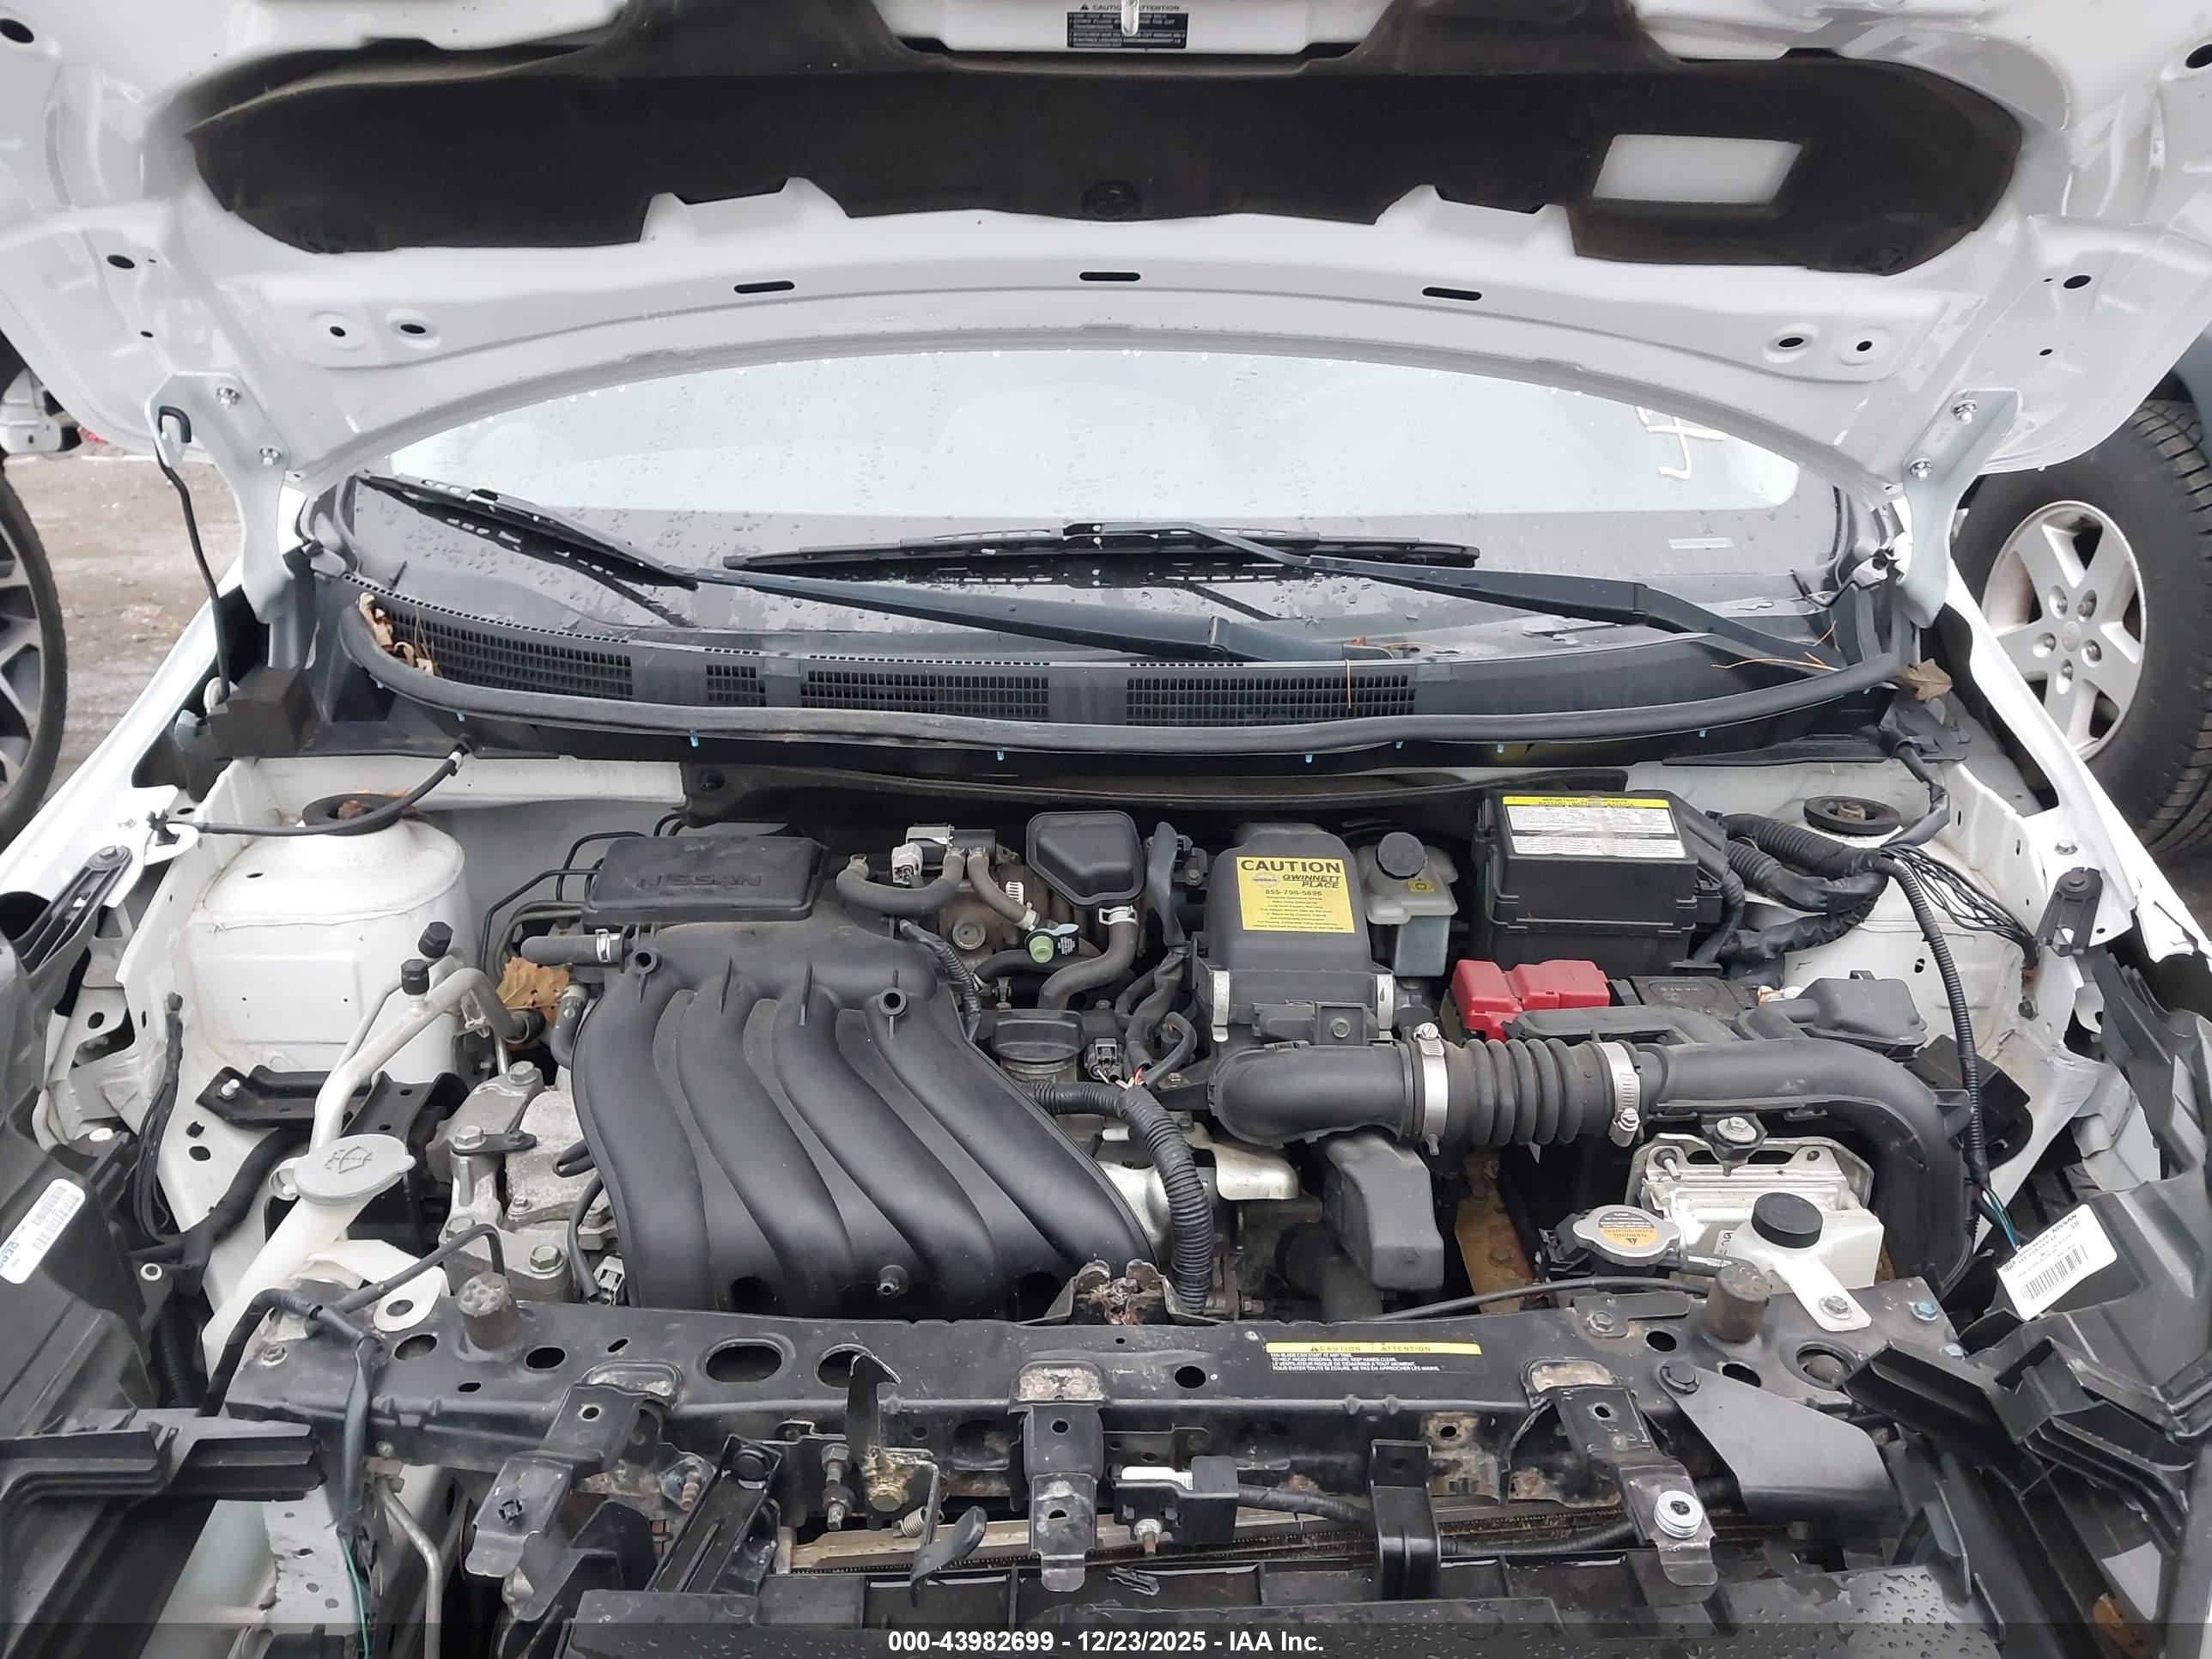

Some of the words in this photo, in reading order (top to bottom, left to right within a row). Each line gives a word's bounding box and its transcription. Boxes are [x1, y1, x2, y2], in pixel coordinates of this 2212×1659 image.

[1241, 860, 1341, 873] CAUTION
[1282, 874, 1341, 883] GWINNETT
[2052, 1214, 2077, 1233] NISSAN
